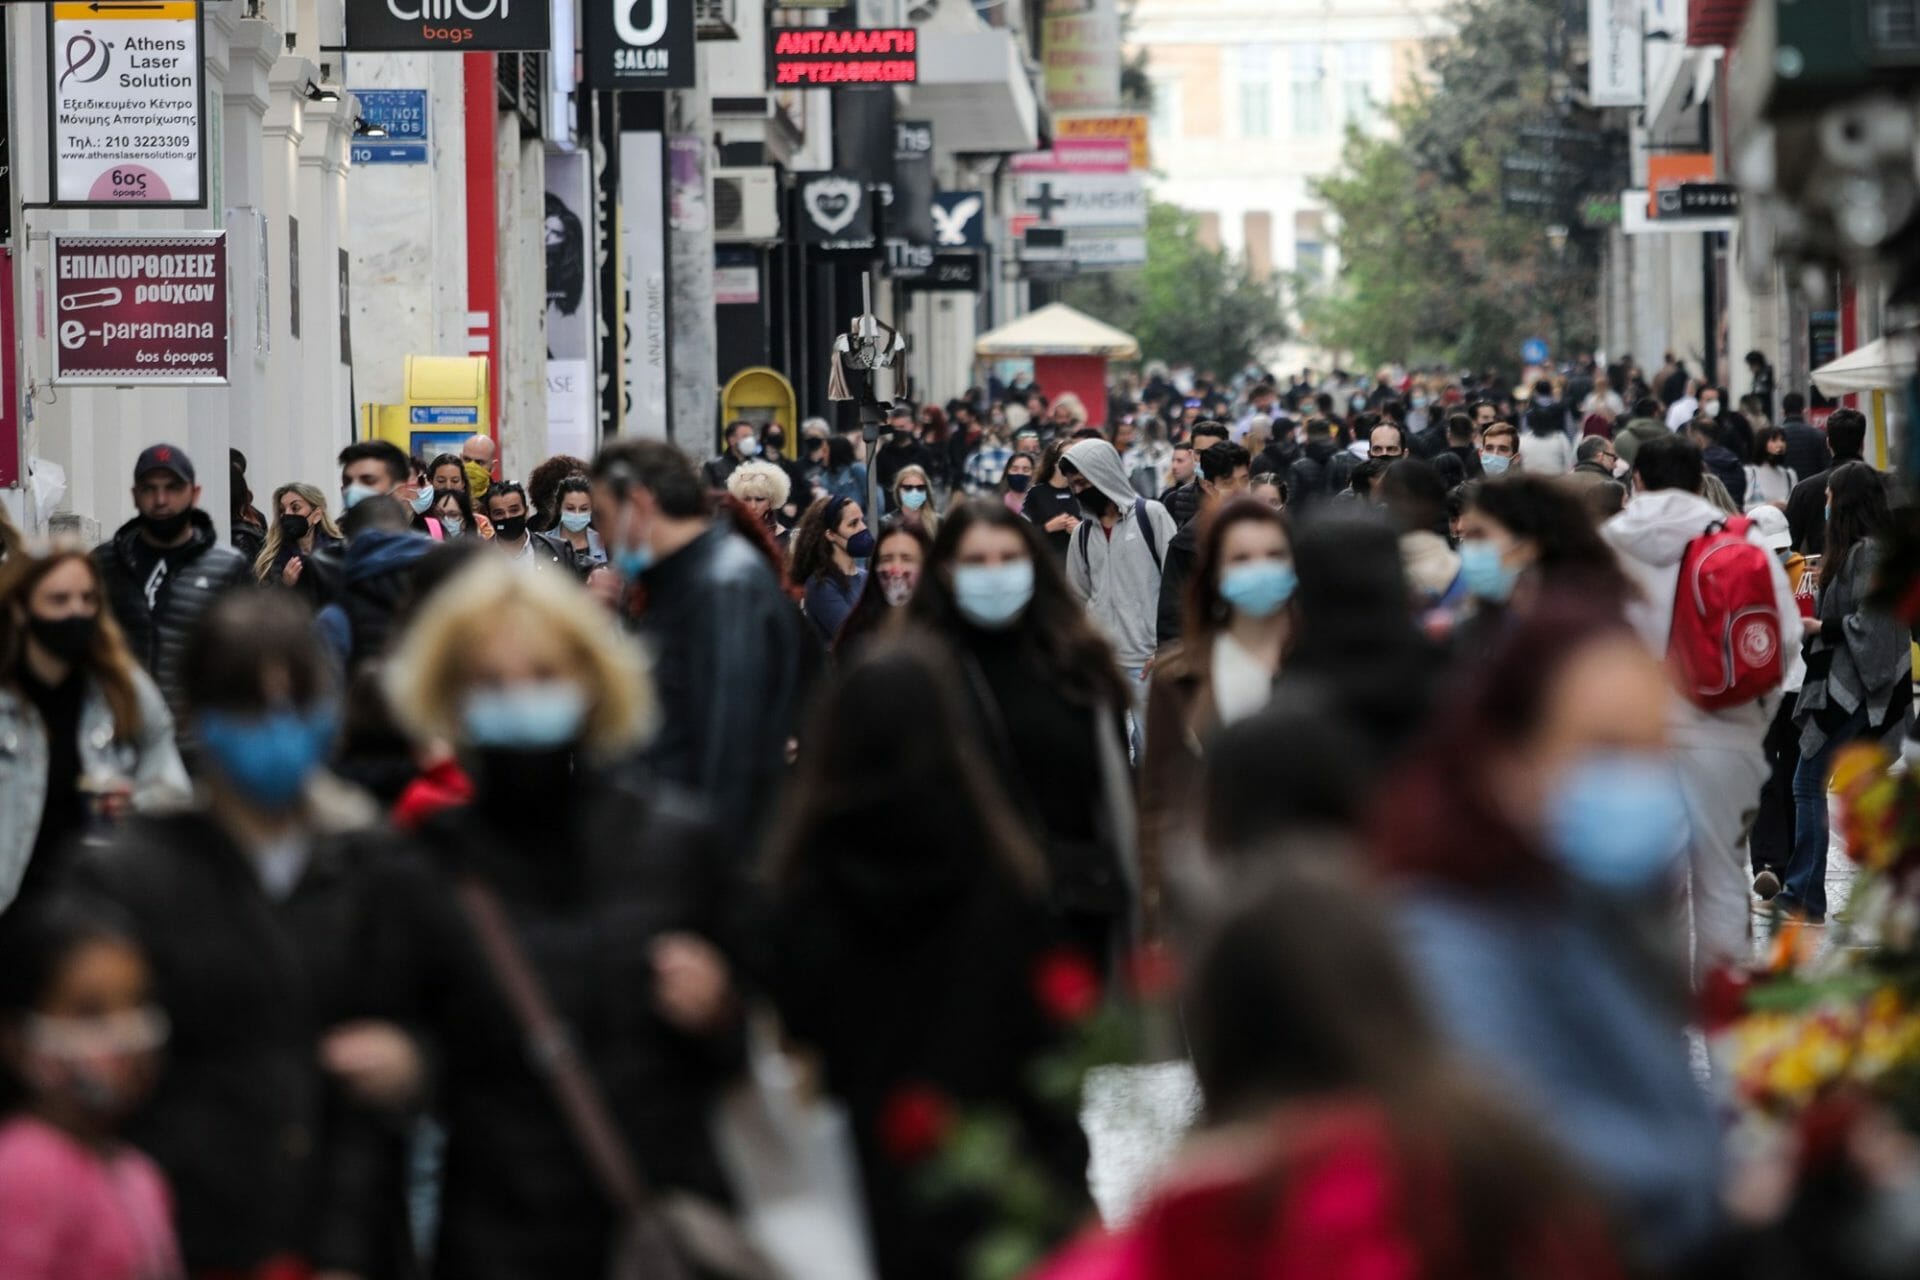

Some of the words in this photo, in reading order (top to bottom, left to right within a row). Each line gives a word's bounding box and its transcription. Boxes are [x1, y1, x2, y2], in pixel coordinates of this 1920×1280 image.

[423, 24, 473, 44] bags
[124, 37, 186, 51] Athens
[130, 55, 179, 69] Laser
[614, 48, 669, 70] SALON
[119, 74, 192, 88] Solution
[63, 98, 146, 111] Εξειδικευμένο
[150, 98, 192, 111] Κέντρο
[59, 113, 111, 127] Μόνιμης
[113, 113, 196, 127] Αποτρίχωσης
[67, 136, 101, 150] Τηλ.:
[106, 136, 130, 148] 210
[134, 136, 190, 148] 3223309
[61, 151, 197, 161] www.athenslasersolution.gr
[112, 170, 147, 189] 6ος
[112, 188, 146, 198] όροφος
[60, 254, 216, 279] ΕΠΙΔΙΟΡΘΩΣΕΙΣ
[135, 281, 215, 304] ρούχων
[647, 277, 662, 366] ANATOMIC
[60, 320, 214, 350] e-paramana
[547, 376, 575, 393] ASE
